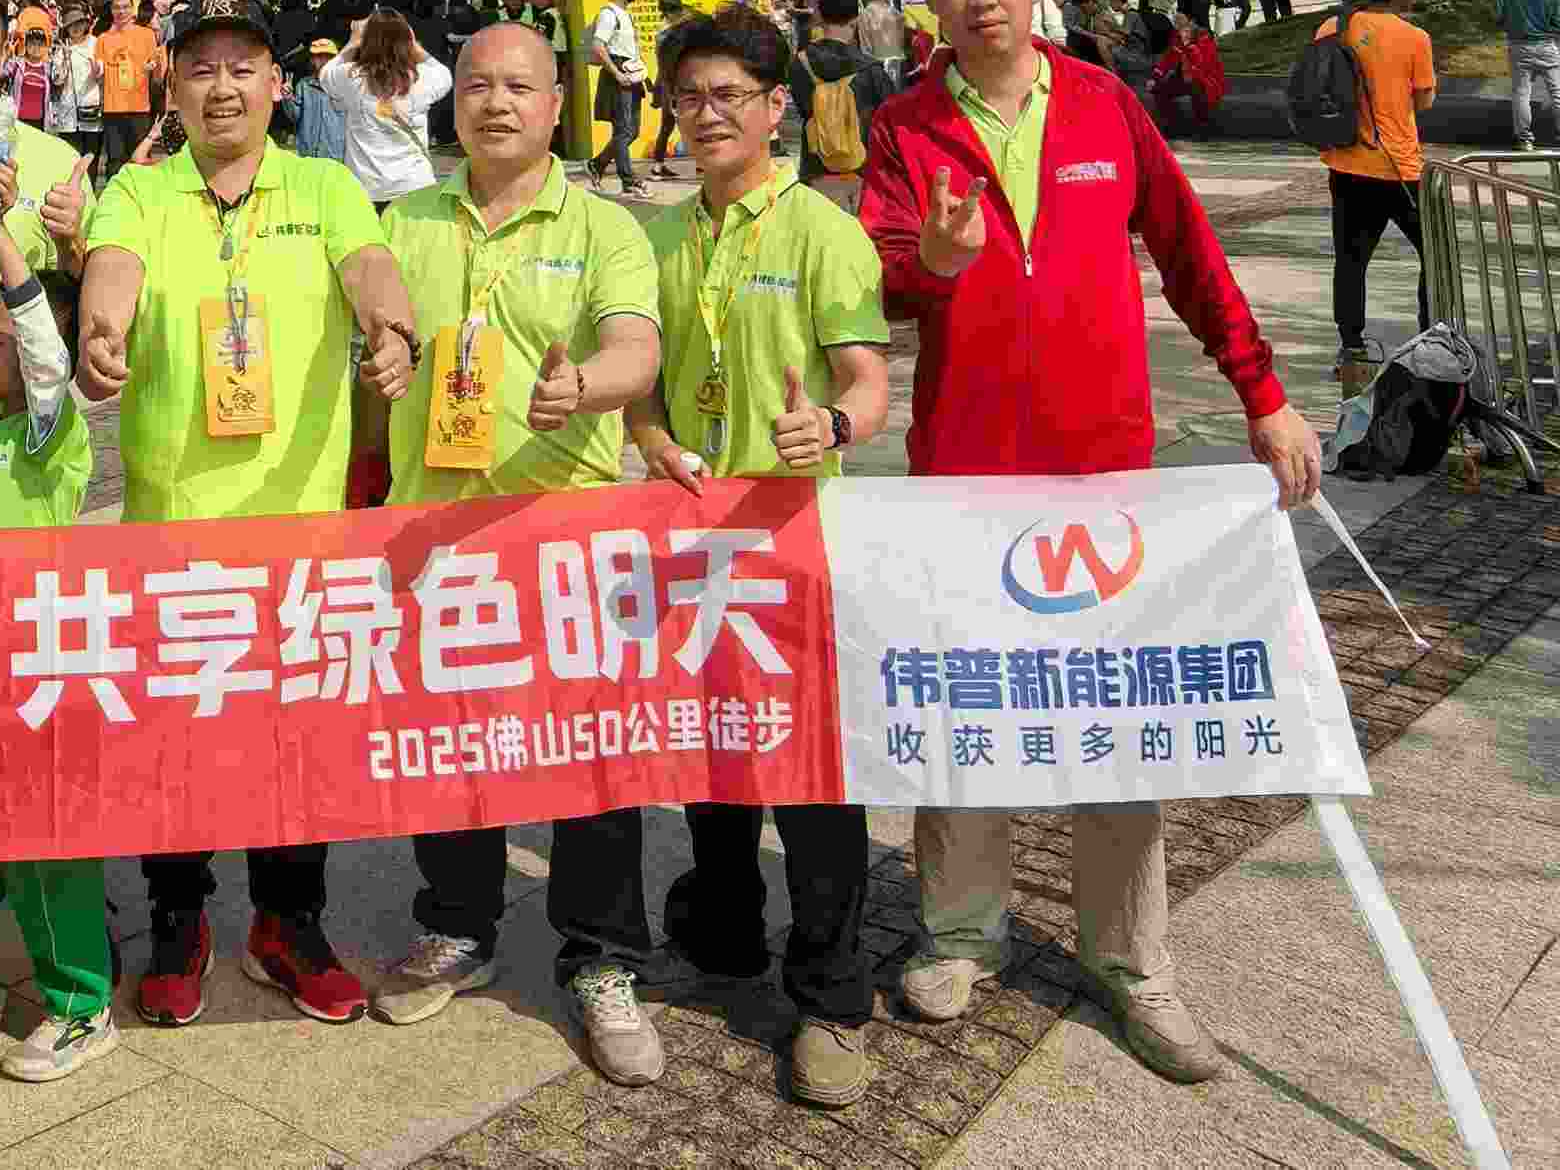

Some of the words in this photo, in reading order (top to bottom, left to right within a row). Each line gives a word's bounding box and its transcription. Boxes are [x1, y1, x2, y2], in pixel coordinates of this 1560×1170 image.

[10, 527, 793, 731] 共享绿色明天
[880, 639, 1277, 710] 伟普新能源集团
[369, 697, 794, 782] 2025佛山50公里徒步
[886, 714, 1283, 768] 收获更多的阳光
